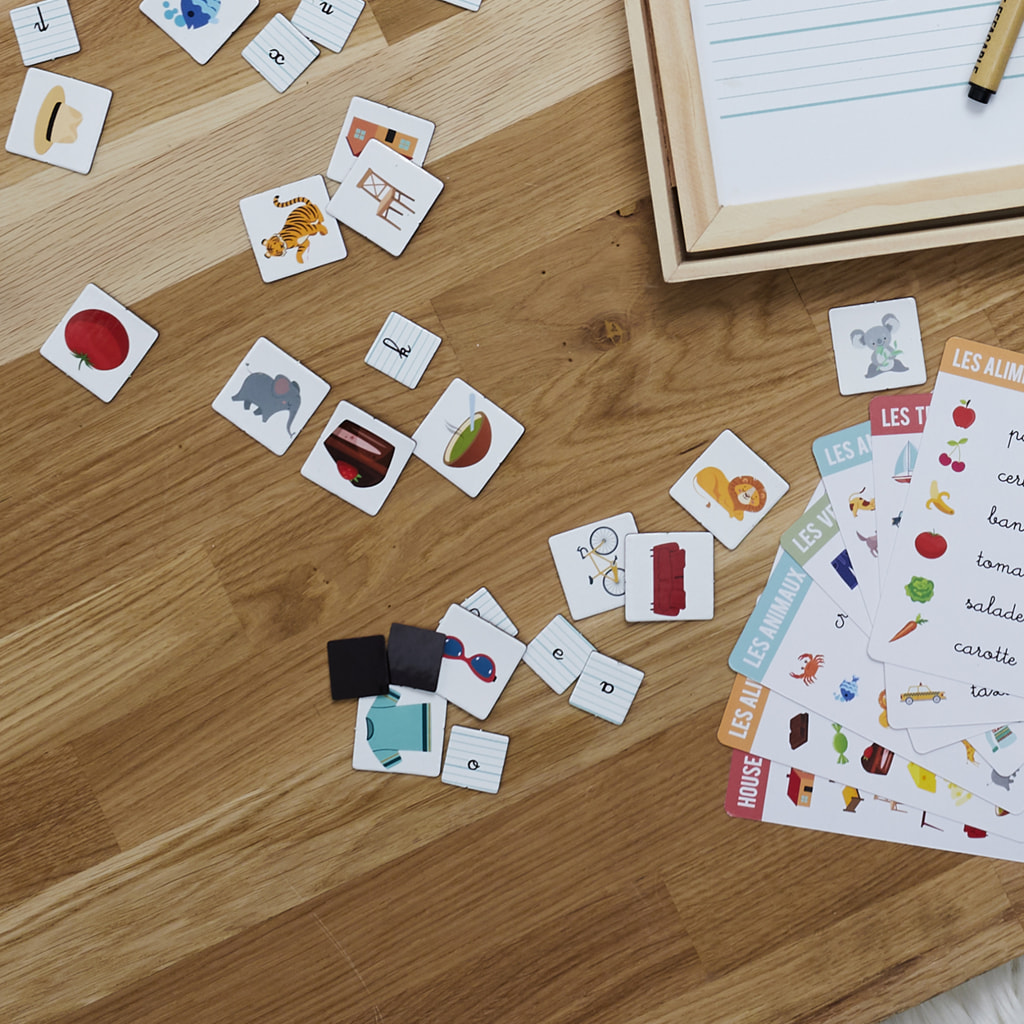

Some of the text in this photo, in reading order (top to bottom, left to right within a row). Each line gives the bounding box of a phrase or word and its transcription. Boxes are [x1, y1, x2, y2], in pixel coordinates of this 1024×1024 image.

[382, 337, 412, 359] k
[952, 348, 983, 372] LES
[881, 407, 910, 427] LES
[824, 441, 855, 466] LES
[791, 522, 823, 554] LES
[742, 566, 807, 669] LES ANIMAUX
[551, 648, 564, 661] e
[953, 642, 1018, 667] carotte
[599, 680, 615, 695] a
[728, 708, 754, 739] LES
[467, 759, 481, 771] o
[737, 755, 763, 808] HOUSE
